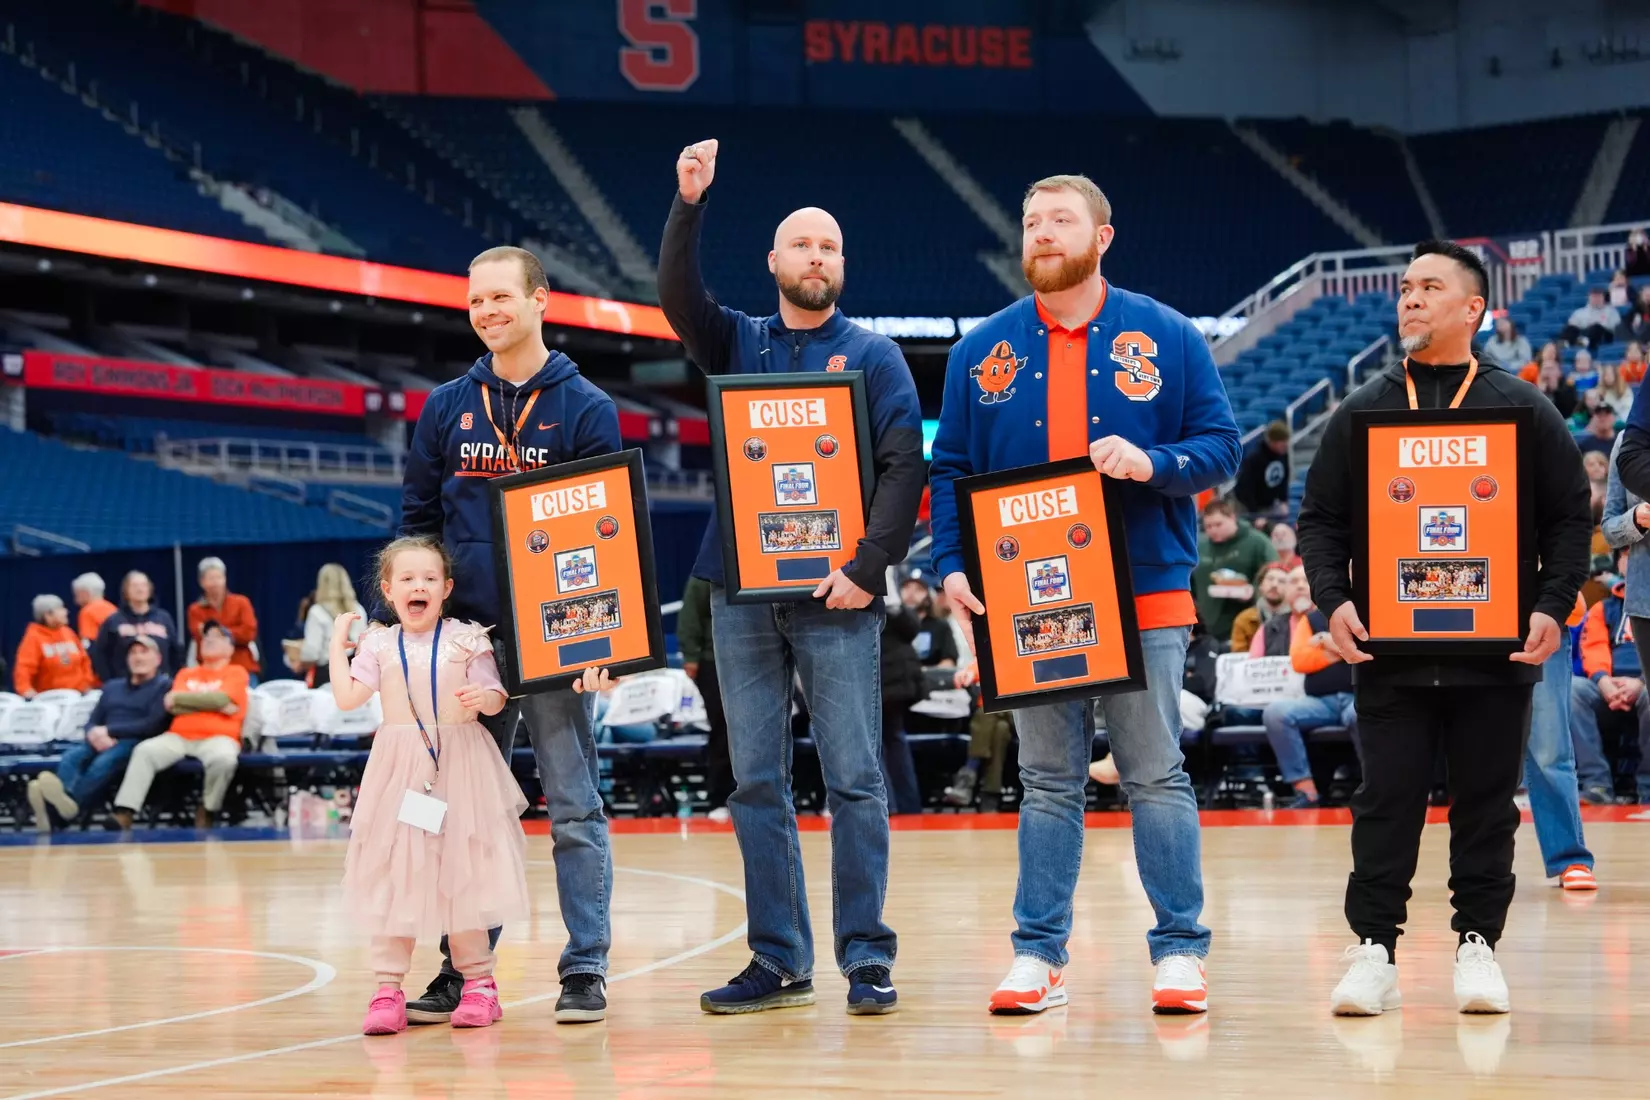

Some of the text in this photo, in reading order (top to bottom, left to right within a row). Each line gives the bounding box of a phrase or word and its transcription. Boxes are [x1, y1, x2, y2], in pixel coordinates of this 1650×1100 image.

[616, 0, 701, 92] S
[804, 19, 1033, 68] SYRACUSE
[92, 364, 169, 391] SIMMONS
[460, 412, 474, 430] S
[751, 400, 820, 427] 'CUSE
[1403, 437, 1479, 466] 'CUSE
[533, 484, 601, 518] 'CUSE
[1002, 488, 1071, 523] 'CUSE
